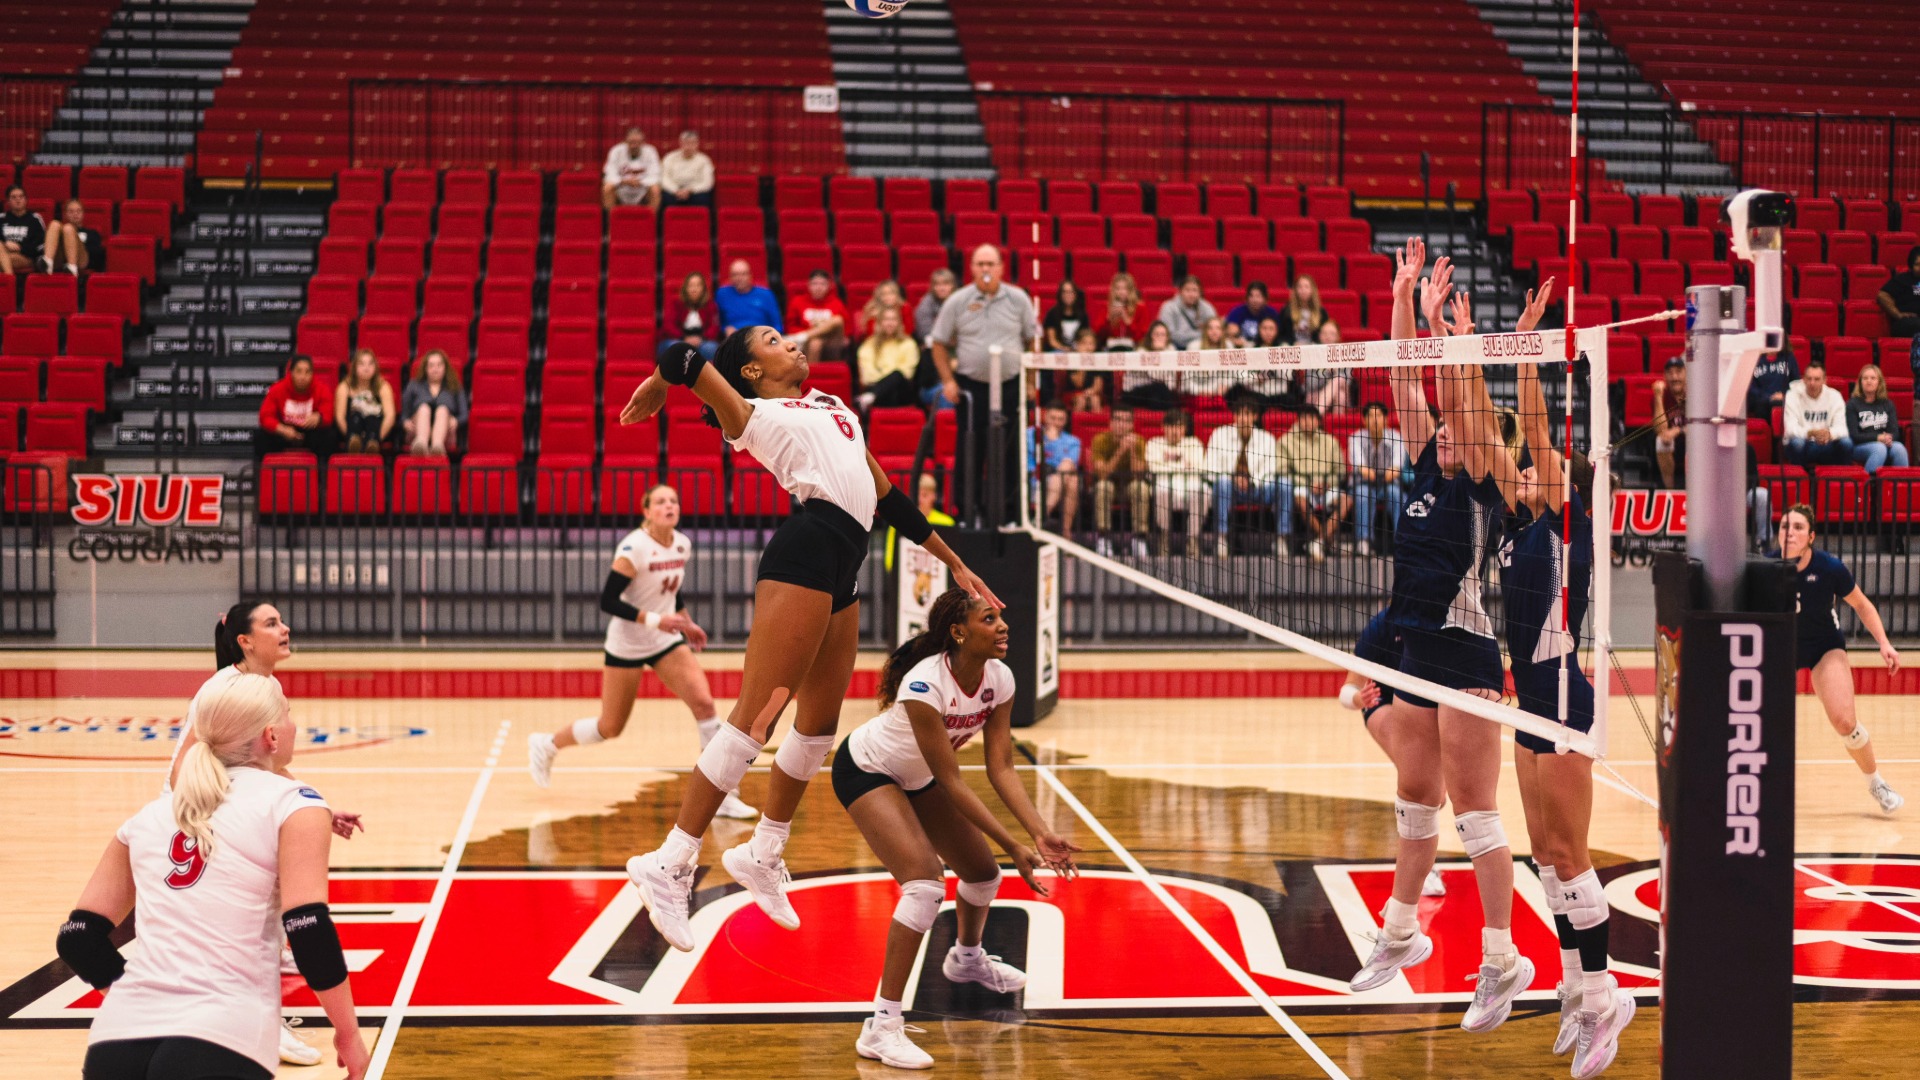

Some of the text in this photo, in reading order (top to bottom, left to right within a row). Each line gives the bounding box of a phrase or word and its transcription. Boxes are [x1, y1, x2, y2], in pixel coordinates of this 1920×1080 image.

[1397, 339, 1443, 360] SIUE COUGARS
[1482, 333, 1543, 356] SIUE COUGARS
[831, 412, 856, 441] 6
[71, 473, 224, 527] SIUE
[1610, 489, 1688, 537] IUE
[68, 535, 223, 563] COUGARS
[163, 828, 213, 890] 9
